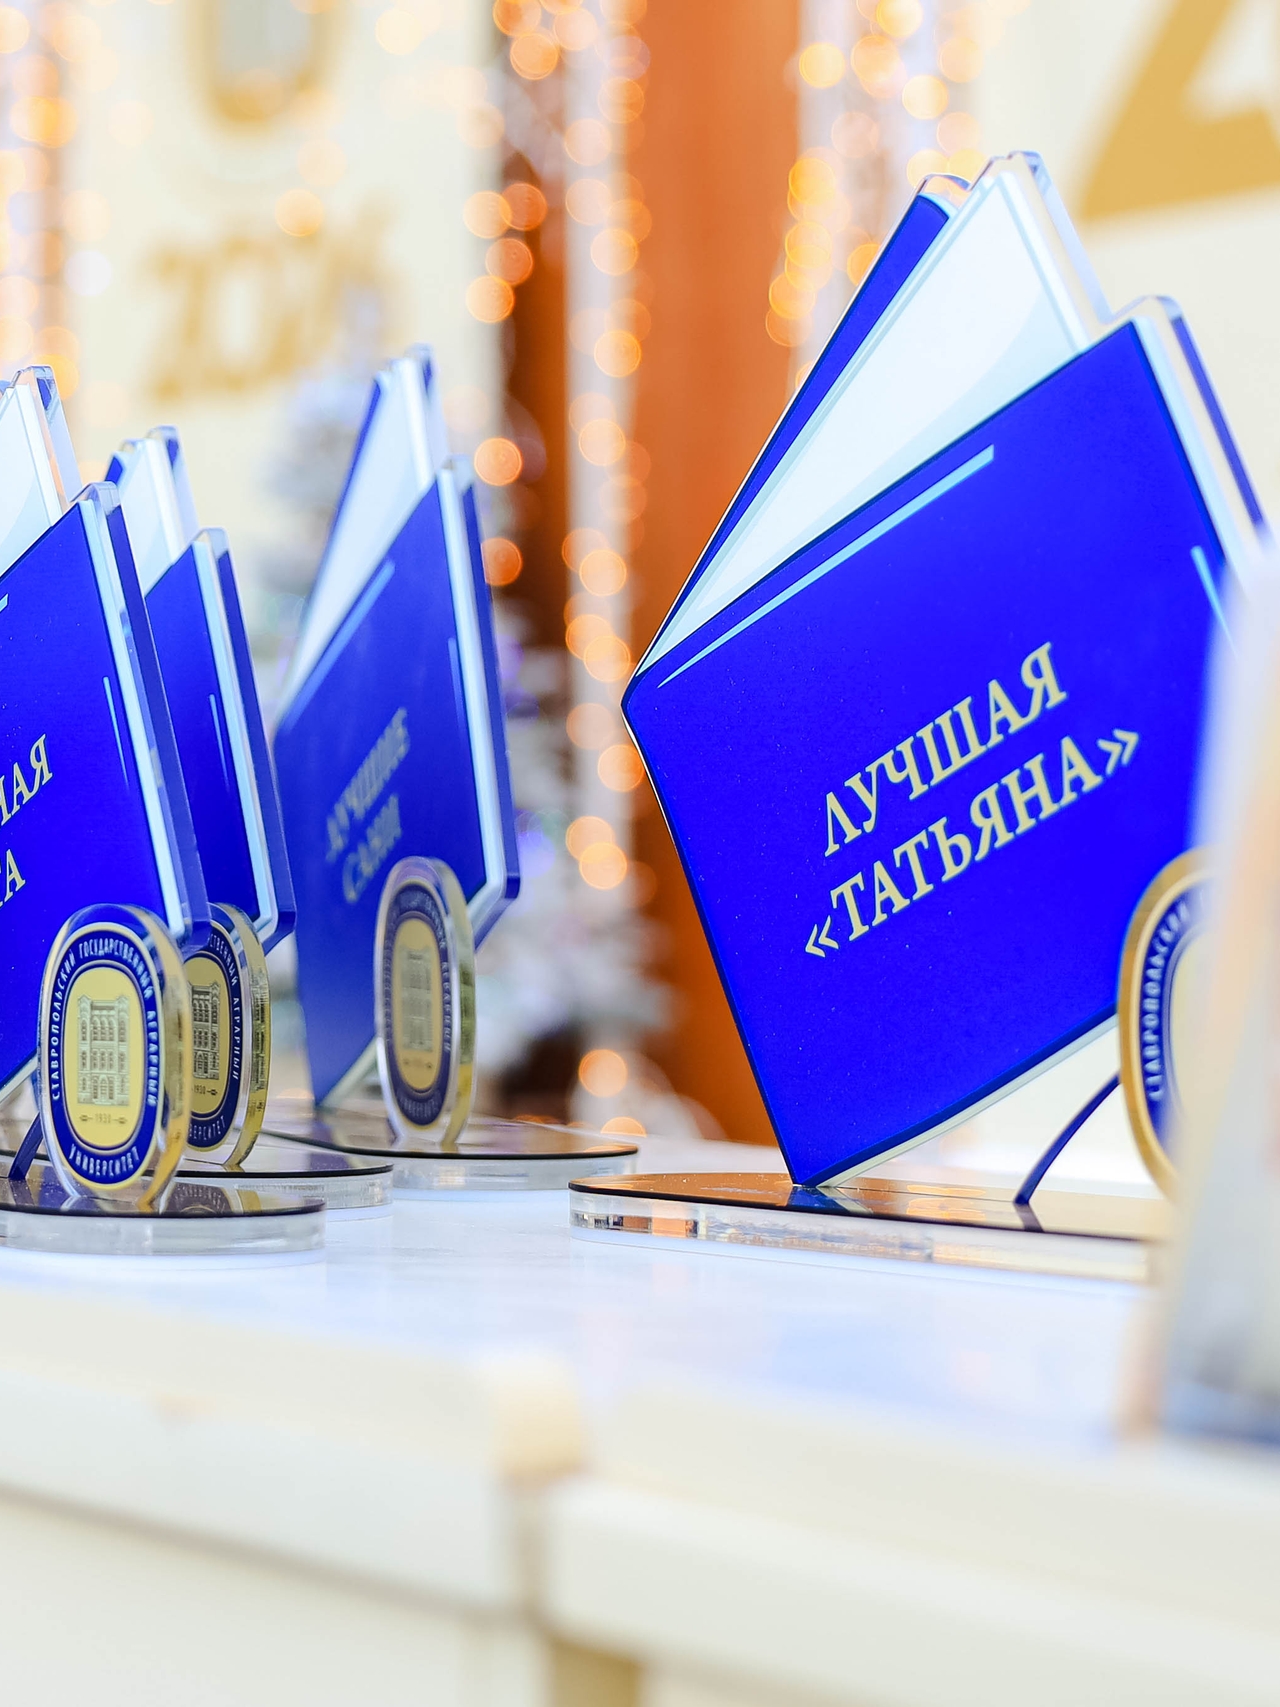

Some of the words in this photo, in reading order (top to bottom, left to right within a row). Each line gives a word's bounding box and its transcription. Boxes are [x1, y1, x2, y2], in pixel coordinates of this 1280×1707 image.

[804, 728, 1140, 958] «ТАТЬЯНА»
[824, 642, 1068, 857] ЛУЧШАЯ
[51, 949, 78, 1100] СТАВРОПОЛЬСКИЙ
[78, 938, 154, 999] ГОСУДАРСТВЕННЫЙ
[68, 1143, 140, 1177] УНИВЕРСИТЕТ
